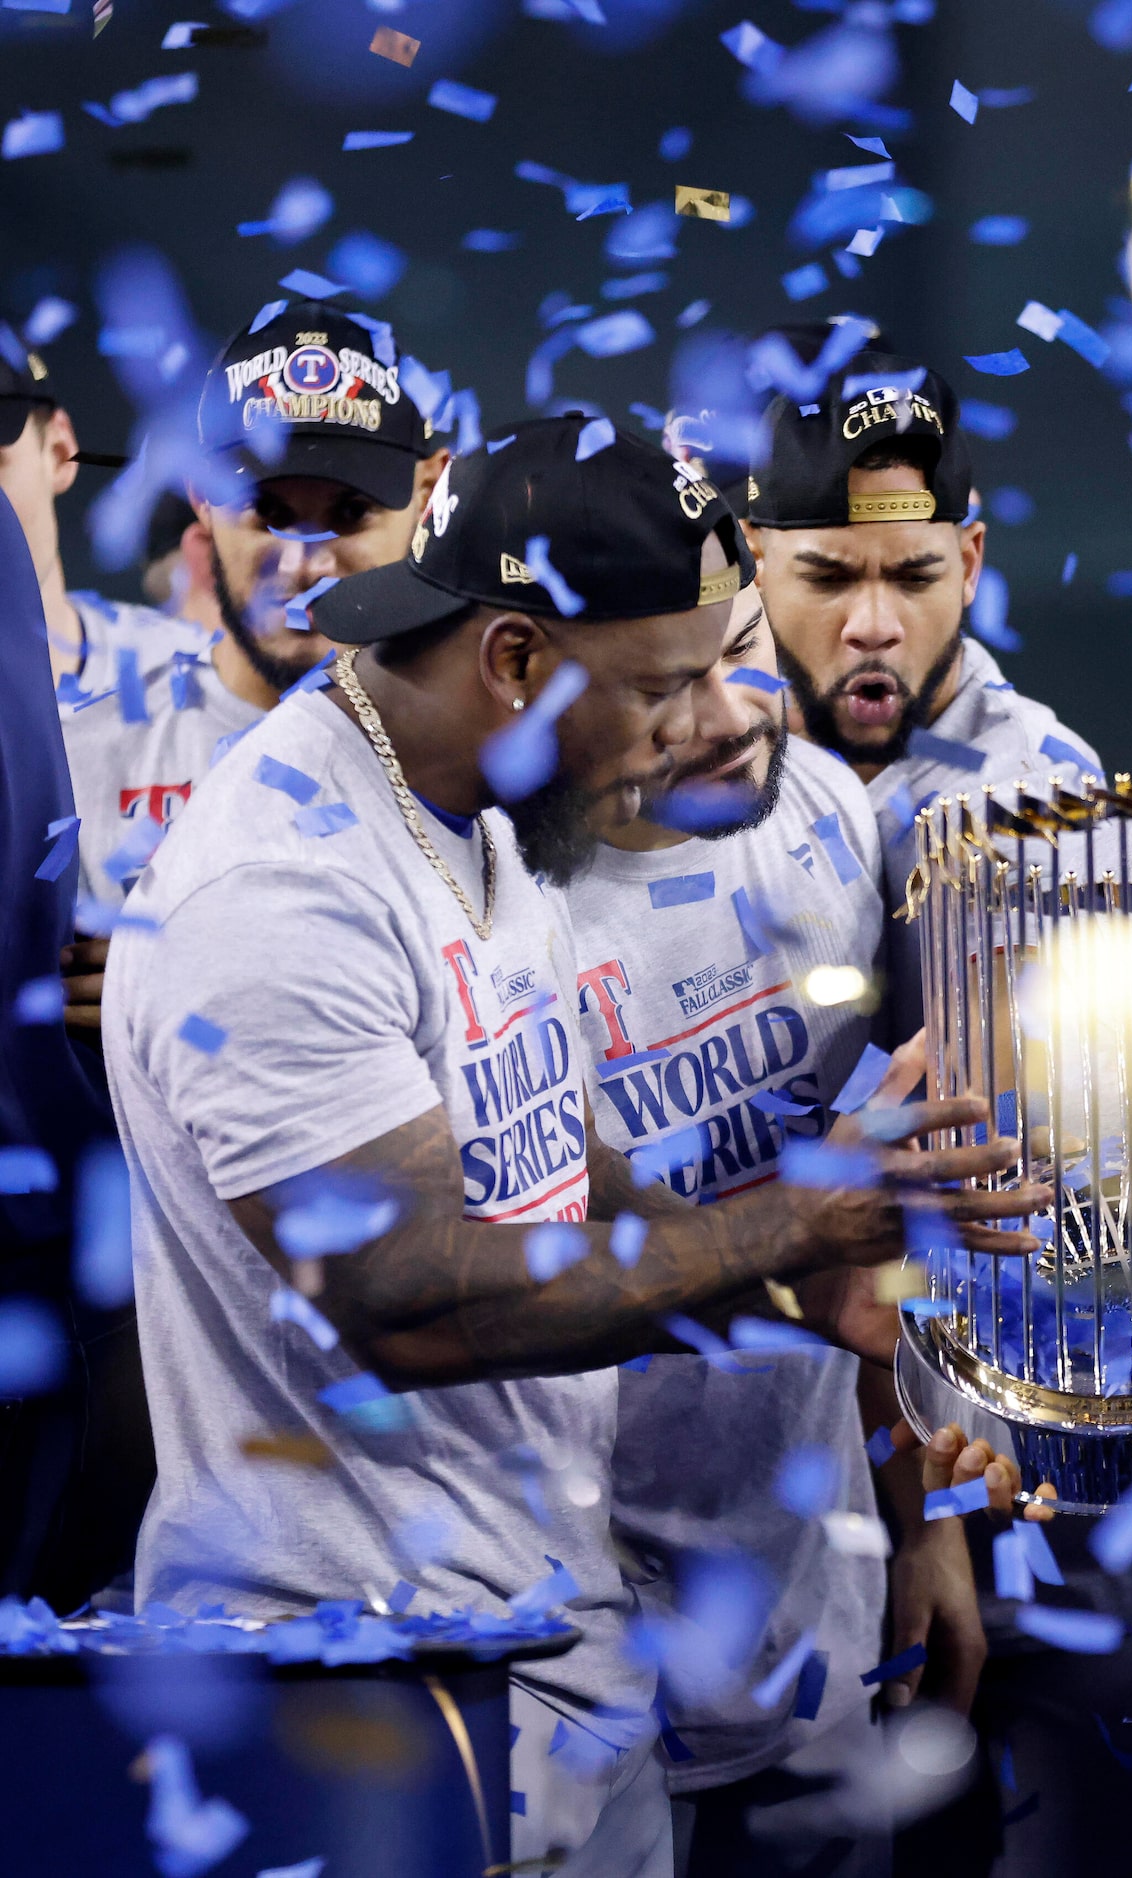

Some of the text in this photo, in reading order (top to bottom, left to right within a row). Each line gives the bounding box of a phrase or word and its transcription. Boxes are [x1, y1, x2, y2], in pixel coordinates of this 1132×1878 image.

[224, 346, 400, 405] WORLD T SERIES
[242, 394, 382, 432] CHAMPIONS
[577, 959, 632, 1061] T
[679, 964, 753, 1015] FALL CLASSIC
[695, 967, 717, 987] 2023
[461, 1019, 569, 1127] WORLD
[599, 1006, 809, 1138] WORLD
[460, 1090, 585, 1206] SERIES
[624, 1072, 826, 1198] ERIES
